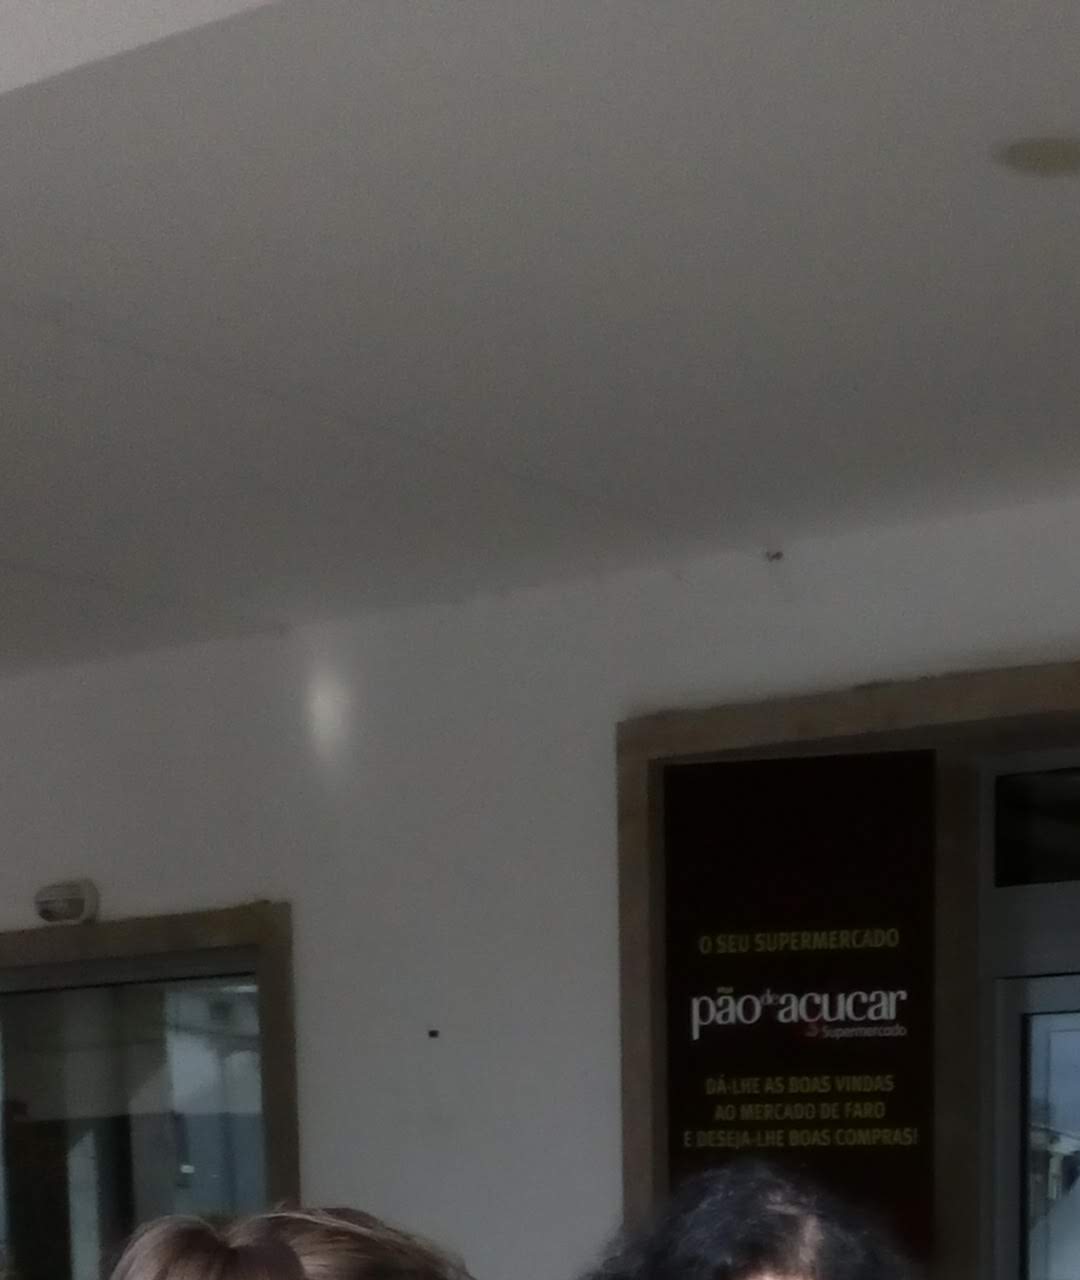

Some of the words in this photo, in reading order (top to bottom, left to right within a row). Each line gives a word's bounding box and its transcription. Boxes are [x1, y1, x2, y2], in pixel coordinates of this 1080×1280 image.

[700, 936, 713, 954] O
[716, 934, 750, 953] SEU
[754, 928, 900, 951] SUPERMERCADO
[691, 987, 762, 1040] pão
[822, 1024, 908, 1039] Supermercado
[706, 1074, 761, 1095] DÁ-LHE
[764, 1077, 785, 1094] AS
[789, 1076, 831, 1094] BOAS
[835, 1074, 895, 1093] VINDAS
[715, 1104, 738, 1121] AO
[740, 1102, 816, 1120] MERCADO
[820, 1103, 840, 1119] DE
[844, 1101, 886, 1119] FARO
[683, 1130, 693, 1147] E
[696, 1129, 785, 1149] DESEJA-LHE
[789, 1128, 832, 1147] BOAS
[835, 1127, 919, 1147] COMPRAS!
